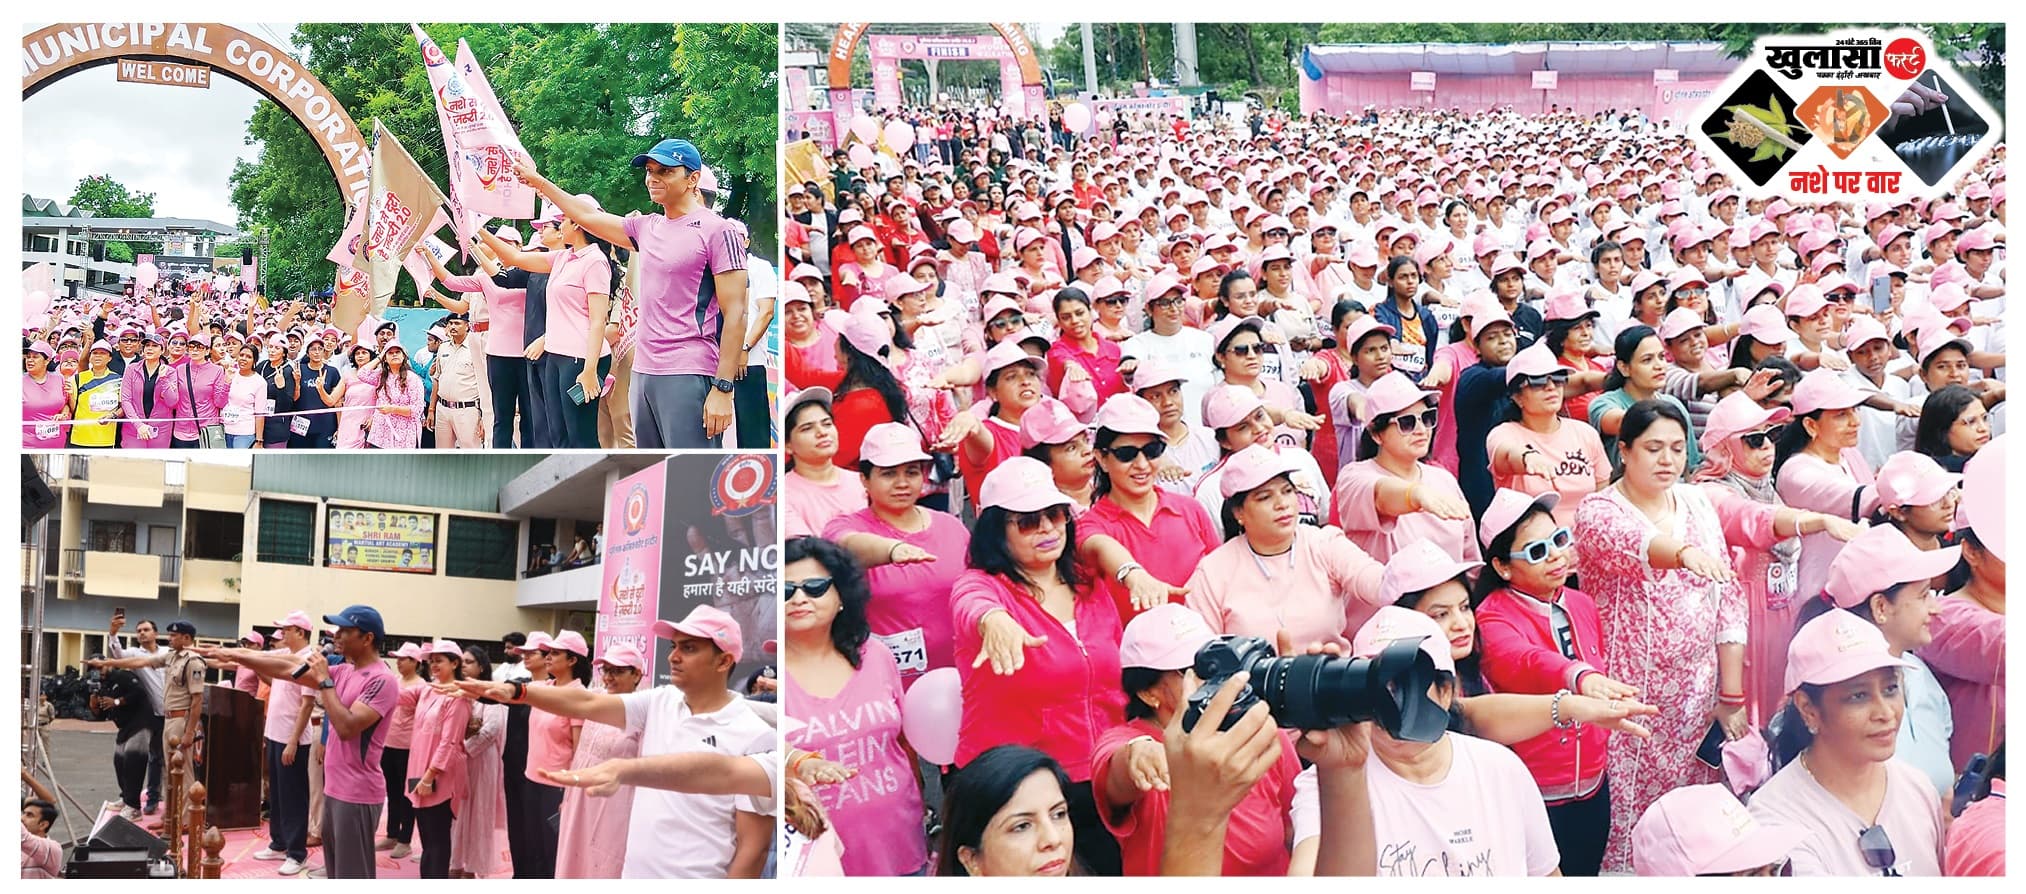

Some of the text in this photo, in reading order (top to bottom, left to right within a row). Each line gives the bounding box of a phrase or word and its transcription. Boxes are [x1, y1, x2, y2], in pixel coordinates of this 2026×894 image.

[122, 62, 207, 85] WEL COME
[363, 531, 401, 540] SHRI RAM
[684, 544, 777, 577] SAY NO
[683, 574, 777, 598] हमारा है यही संदे
[813, 766, 898, 811] EANS
